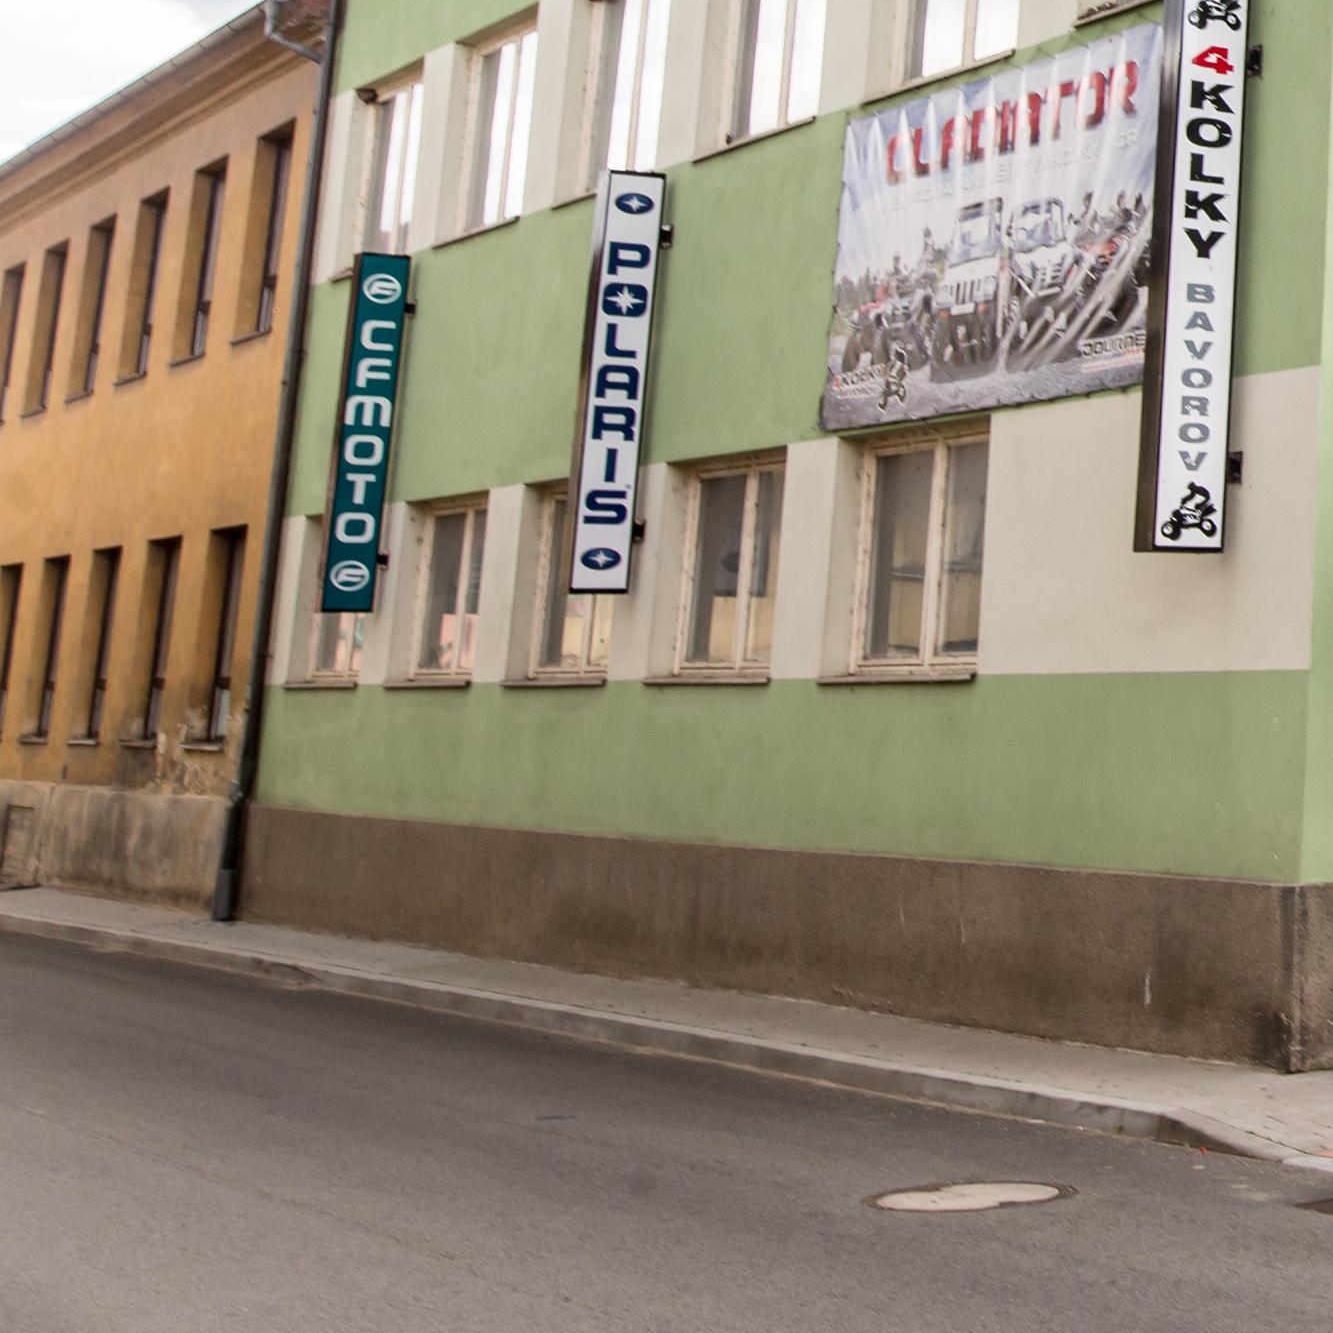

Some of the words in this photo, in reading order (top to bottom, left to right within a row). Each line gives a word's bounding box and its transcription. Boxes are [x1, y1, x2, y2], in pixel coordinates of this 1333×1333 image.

[1184, 45, 1235, 259] 4KOLKY
[335, 320, 397, 544] CFMOTO
[583, 241, 651, 525] POLARIS
[1178, 282, 1217, 472] BAVOROV
